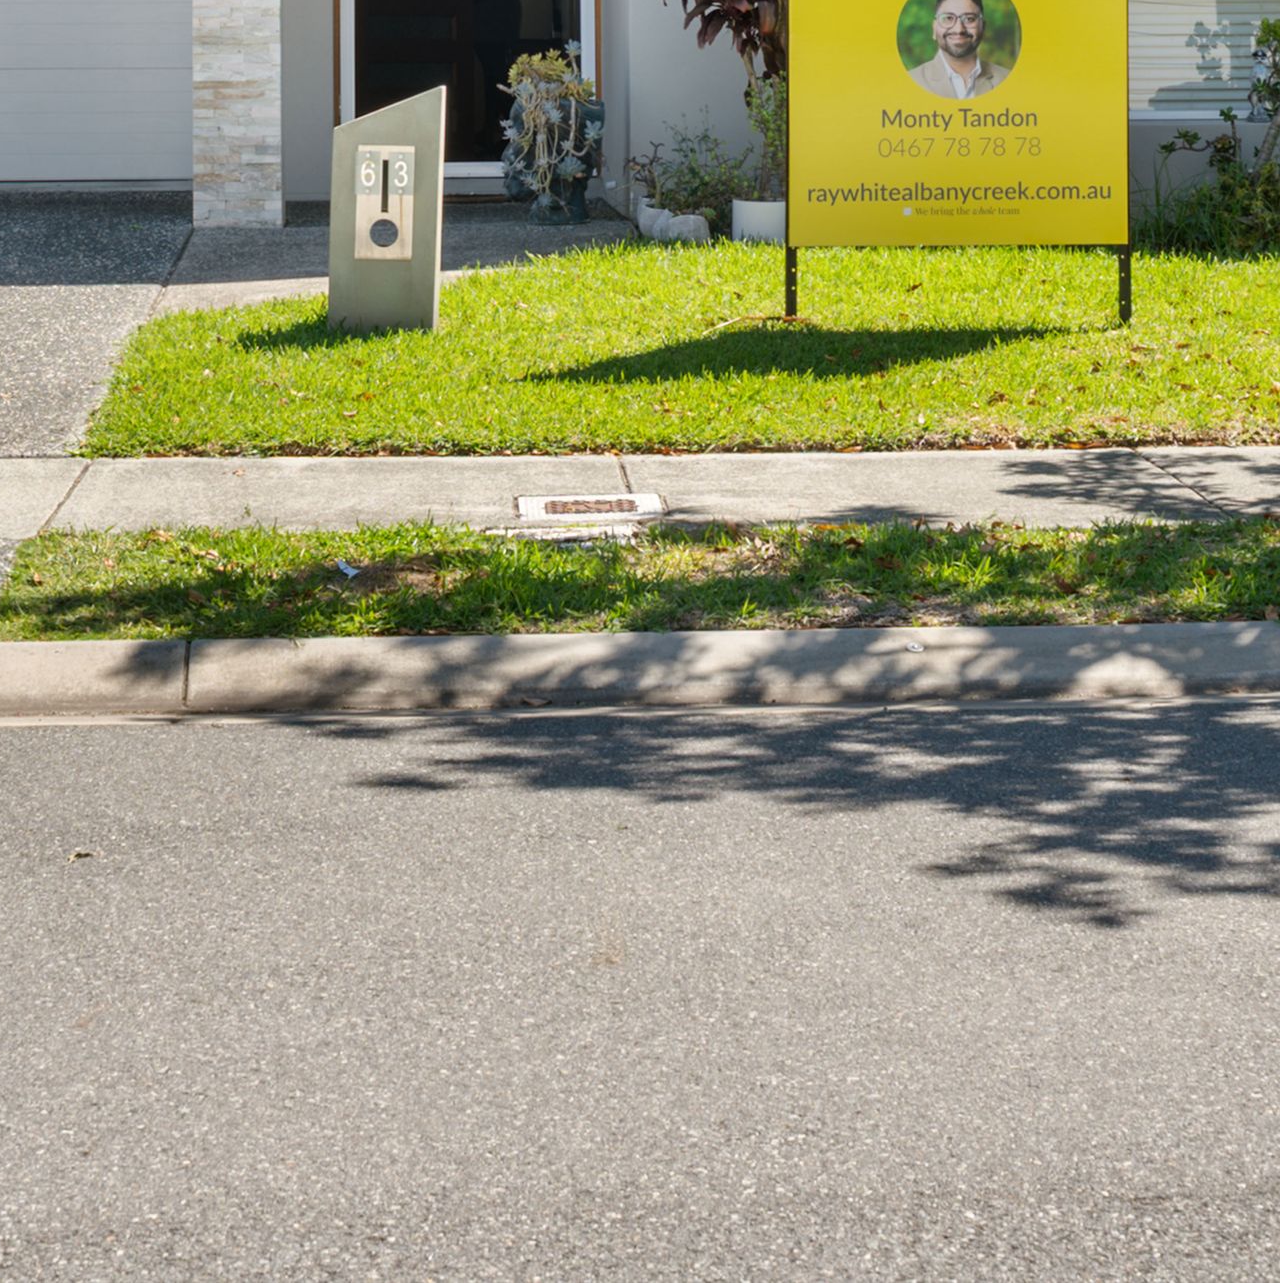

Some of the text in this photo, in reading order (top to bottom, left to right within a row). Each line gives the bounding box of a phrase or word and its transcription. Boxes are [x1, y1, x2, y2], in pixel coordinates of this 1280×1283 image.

[881, 108, 1038, 132] Monty Tandon
[878, 136, 1041, 158] 0467 78 78 78
[808, 181, 1112, 206] raywhitealbanycreek.com.au
[930, 207, 954, 217] bring
[956, 207, 969, 216] the
